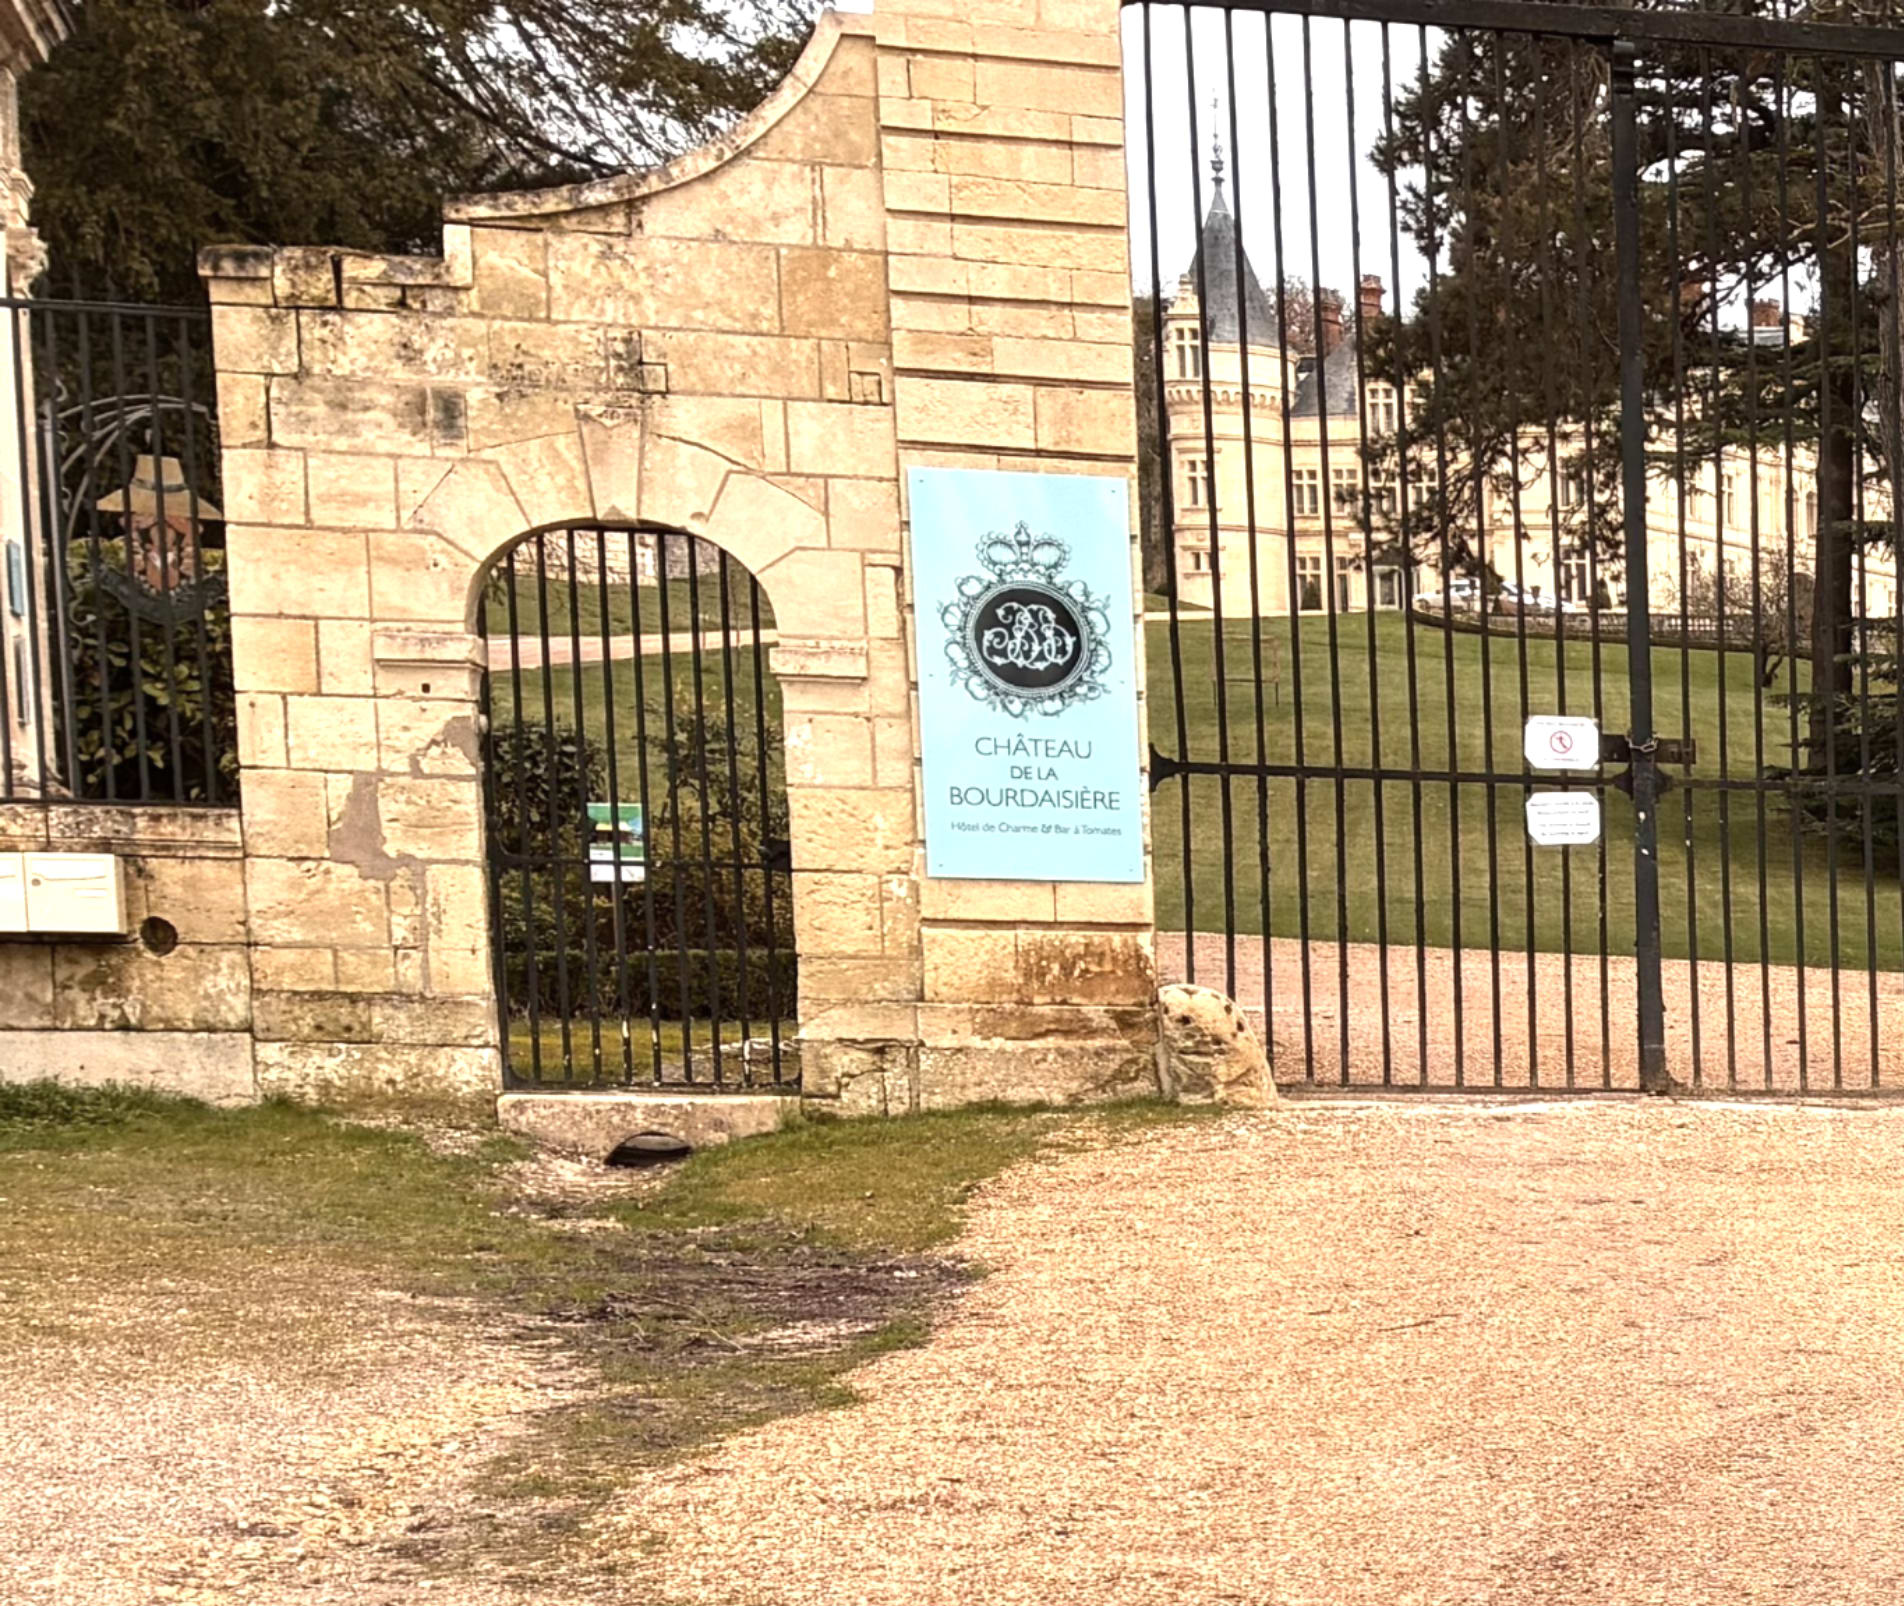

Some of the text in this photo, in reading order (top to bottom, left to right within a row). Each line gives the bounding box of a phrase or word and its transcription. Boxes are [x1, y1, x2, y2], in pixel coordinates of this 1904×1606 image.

[975, 733, 1092, 759] CHÂTEAU
[1010, 765, 1059, 781] DE LA
[949, 785, 1121, 811] BOURDAISIÈRE
[951, 821, 980, 832] Hôtel
[982, 822, 996, 832] de
[998, 822, 1039, 833] Charme
[1054, 824, 1071, 834] Bar
[1081, 824, 1122, 836] Tomates
